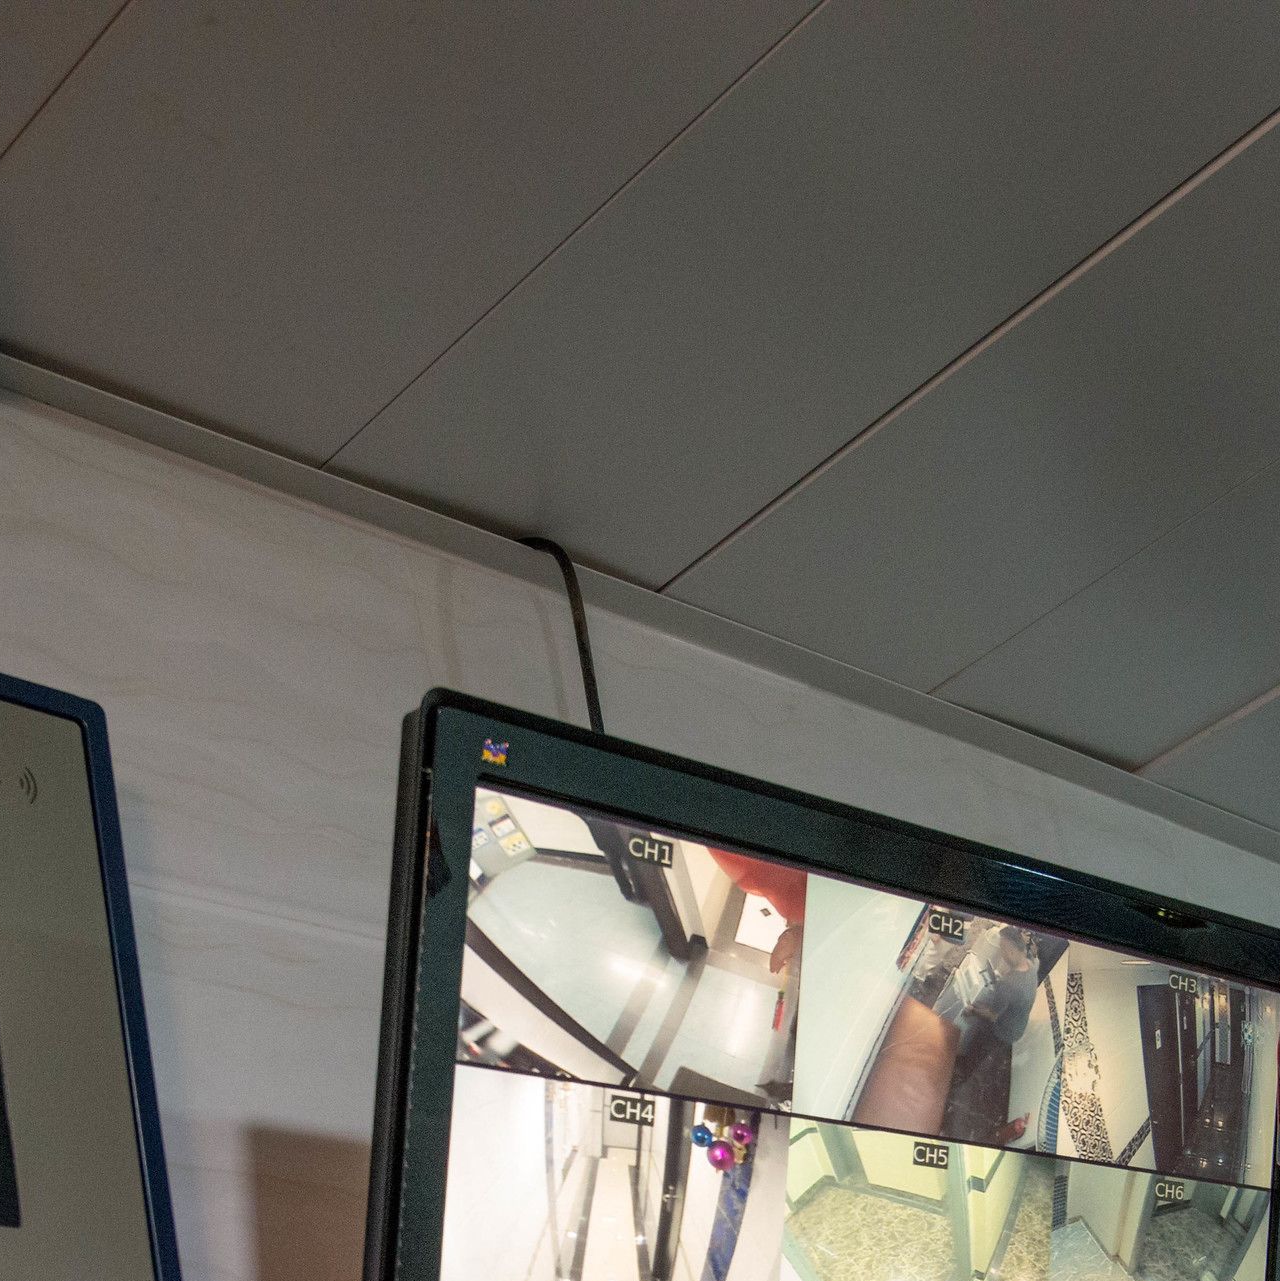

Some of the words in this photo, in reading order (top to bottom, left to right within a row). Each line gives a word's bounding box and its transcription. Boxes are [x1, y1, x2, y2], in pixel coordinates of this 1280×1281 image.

[628, 838, 672, 867] CH1
[929, 914, 963, 937] CH2
[1168, 973, 1198, 994] CH3
[610, 1098, 655, 1123] CH4
[913, 1145, 949, 1167] CH5
[1155, 1182, 1185, 1201] CH6
